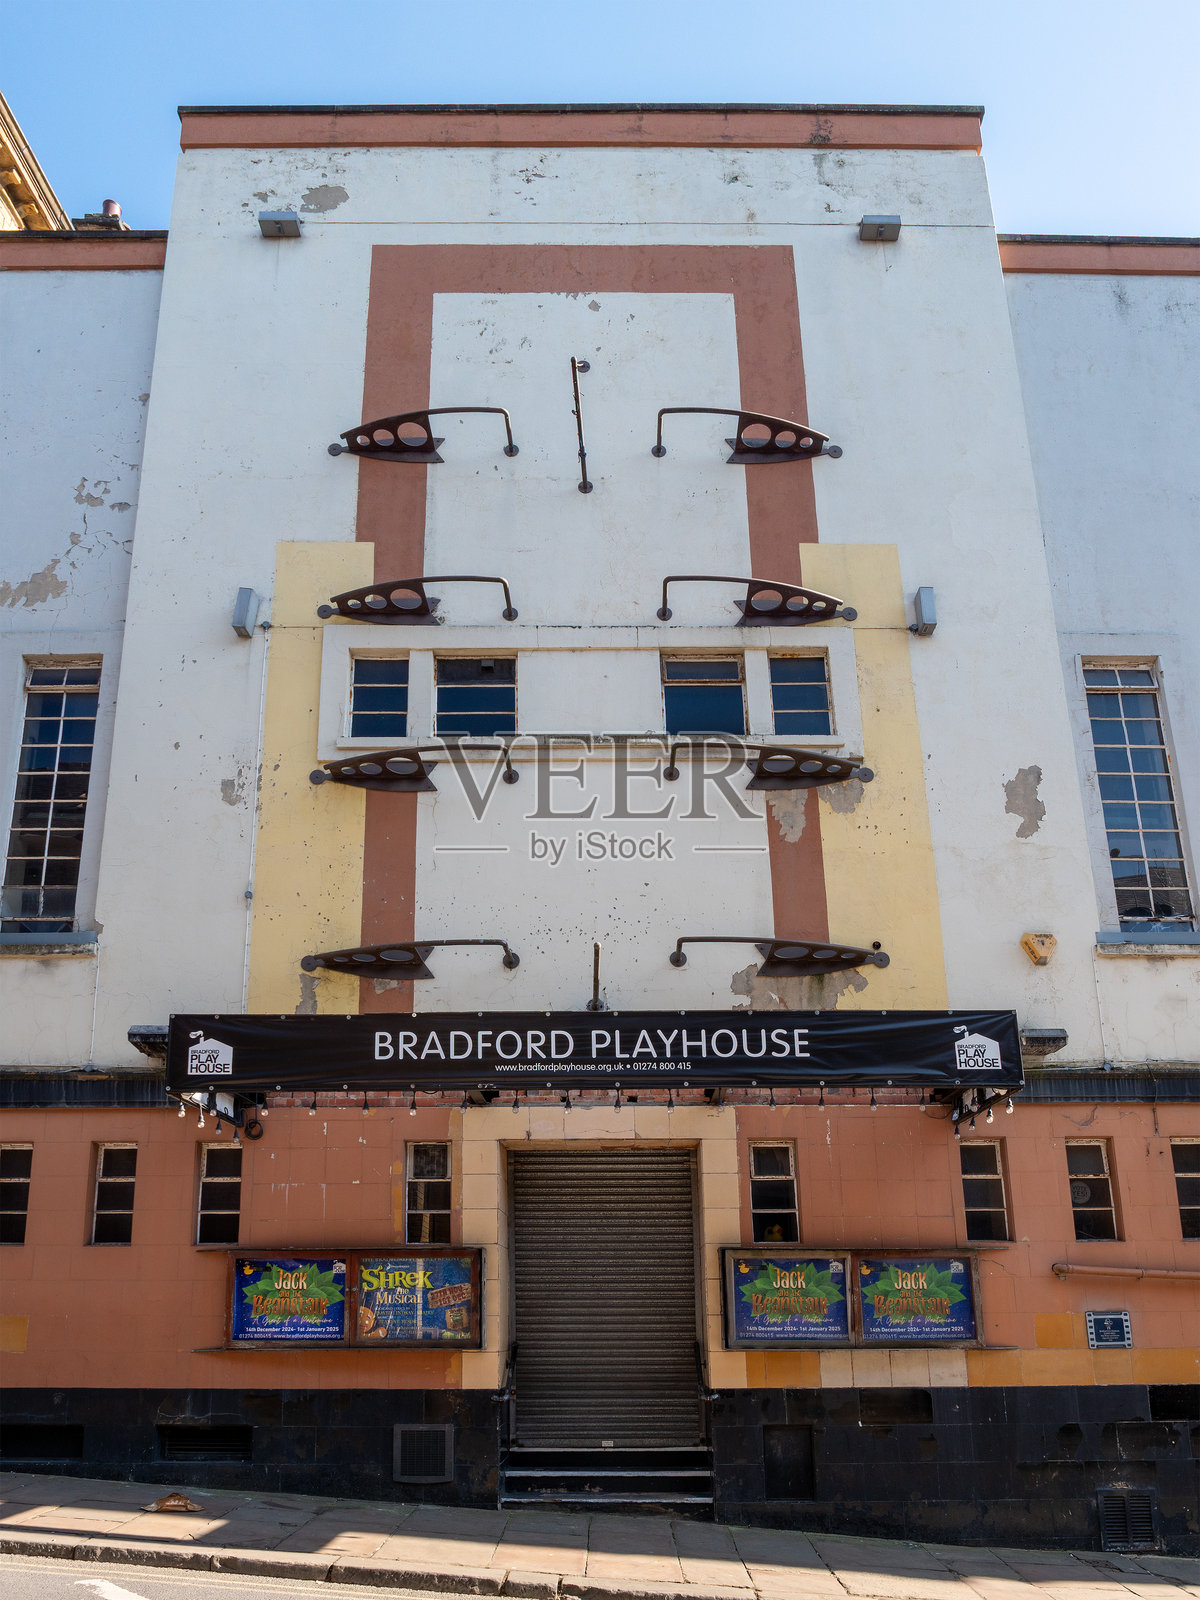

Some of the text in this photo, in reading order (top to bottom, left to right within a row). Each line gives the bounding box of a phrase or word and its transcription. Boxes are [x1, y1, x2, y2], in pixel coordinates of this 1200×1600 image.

[374, 1029, 811, 1060] BRADFORD PLAYHOUSE
[958, 1049, 986, 1058] PLAY
[190, 1055, 219, 1063] PLAY
[190, 1063, 230, 1073] HOUSE
[495, 1062, 691, 1072] www.bradfordplayhouse.org.uk 01274 800 415
[959, 1058, 1000, 1068] HOUSE
[274, 1269, 308, 1290] Jack
[773, 1267, 806, 1289] Jack
[894, 1268, 927, 1290] Jack
[253, 1294, 328, 1315] Beanstalk
[752, 1293, 829, 1315] Beanstalk
[874, 1294, 951, 1315] Beanstalk
